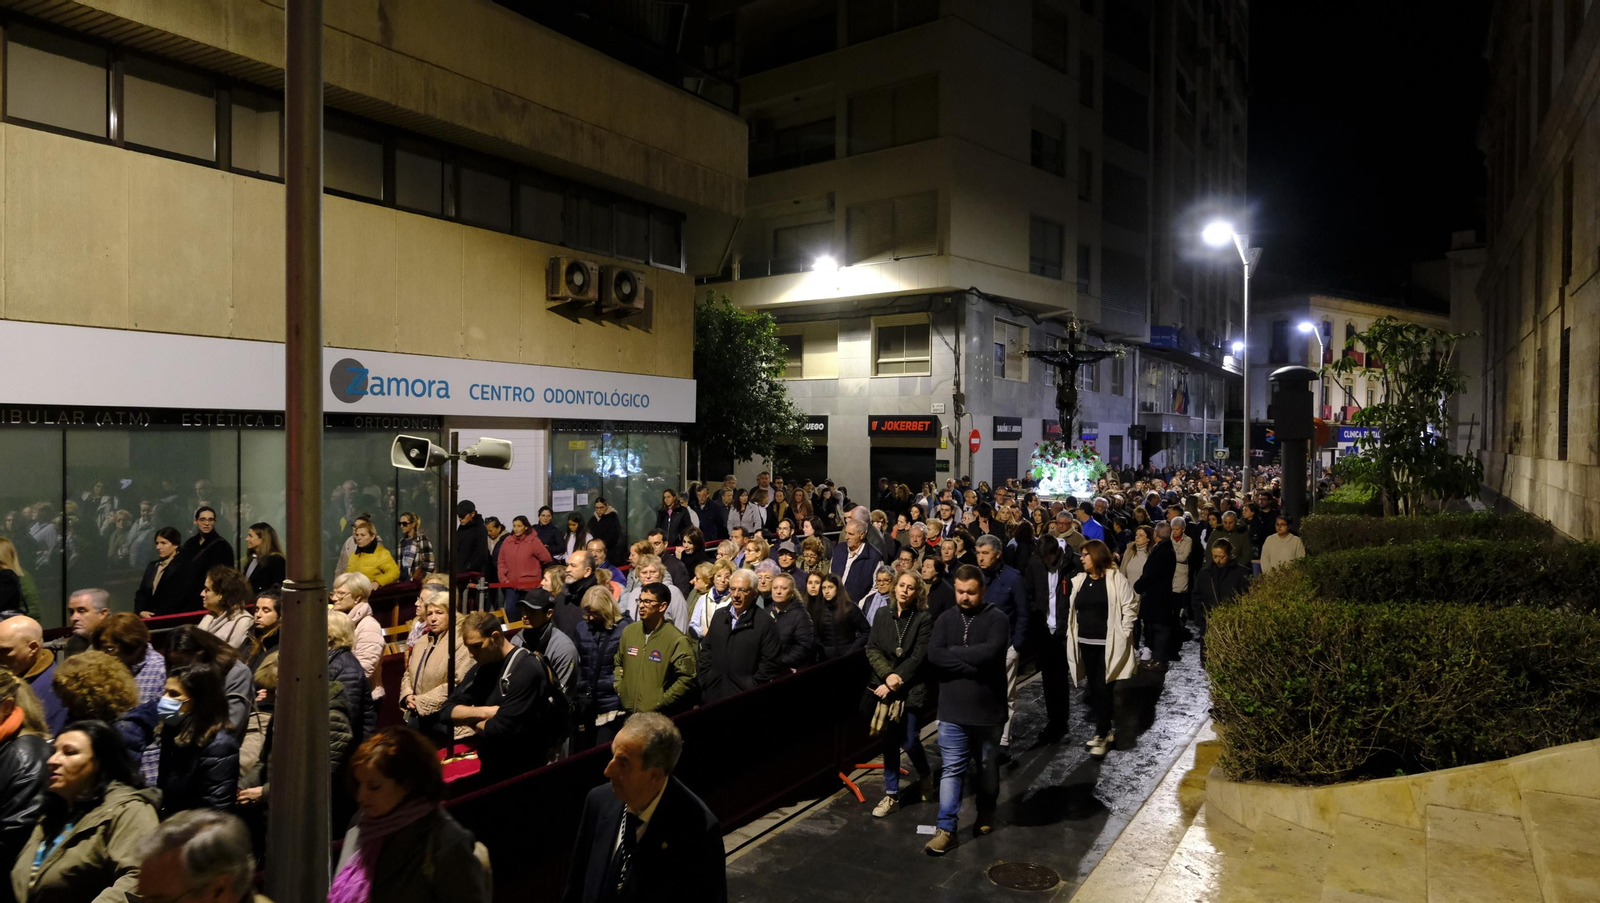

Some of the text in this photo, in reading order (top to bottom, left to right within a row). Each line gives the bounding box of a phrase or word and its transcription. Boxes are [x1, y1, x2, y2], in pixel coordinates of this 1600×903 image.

[345, 366, 451, 399] Zamora
[469, 383, 650, 408] CENTRO ODONTOLÓGICO
[95, 411, 150, 427] (ATM)
[181, 410, 265, 428] ESTÉTICA
[353, 416, 441, 430] ORTODONCIA
[881, 420, 931, 431] JOKERBET
